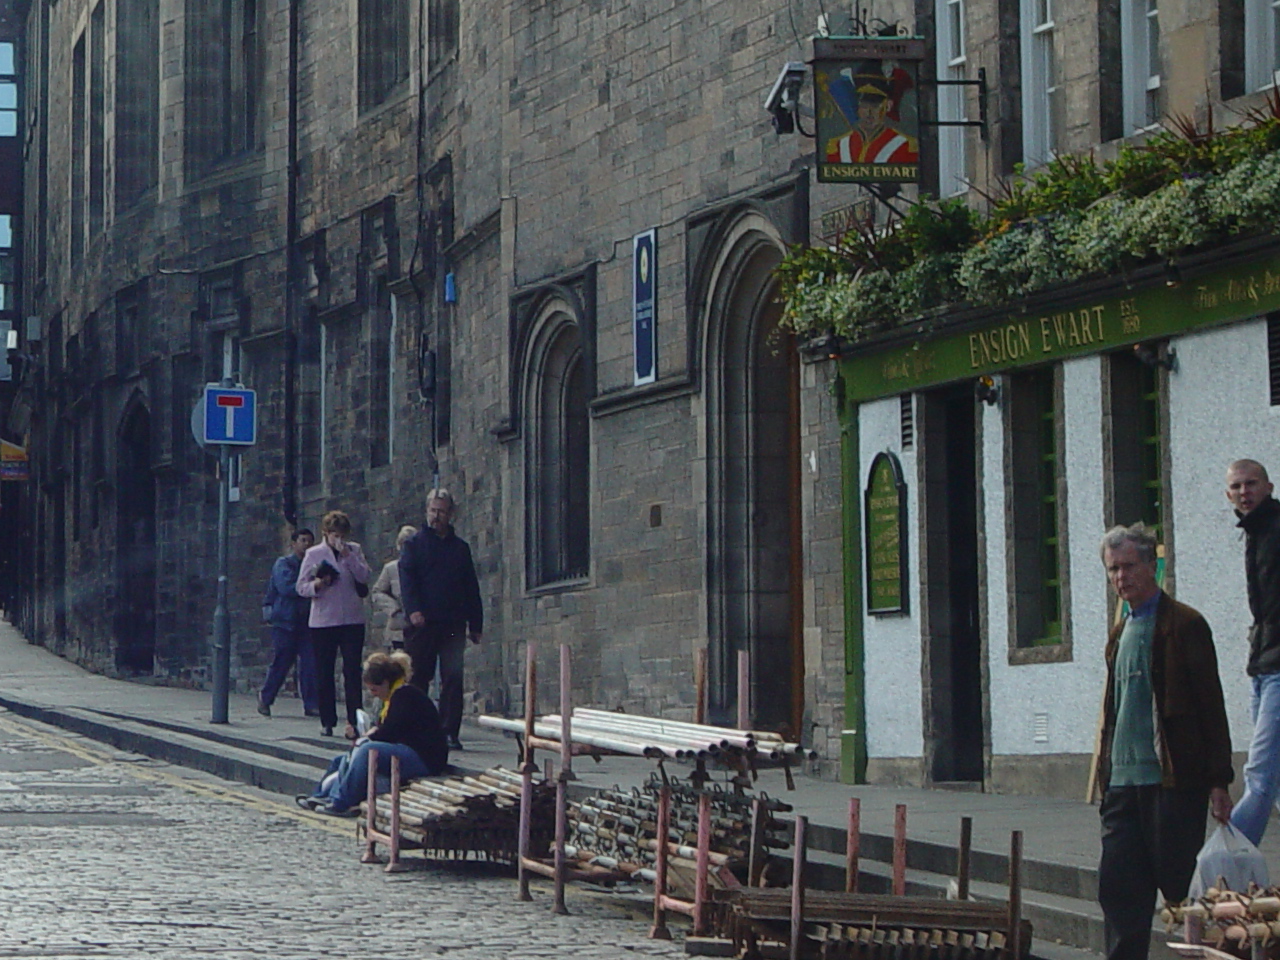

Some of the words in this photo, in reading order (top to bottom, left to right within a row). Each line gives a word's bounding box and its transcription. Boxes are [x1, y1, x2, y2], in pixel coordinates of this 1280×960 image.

[823, 166, 869, 178] ENSIGN
[872, 166, 918, 178] EWART
[969, 323, 1032, 368] ENSIGN
[1041, 306, 1106, 352] EWART
